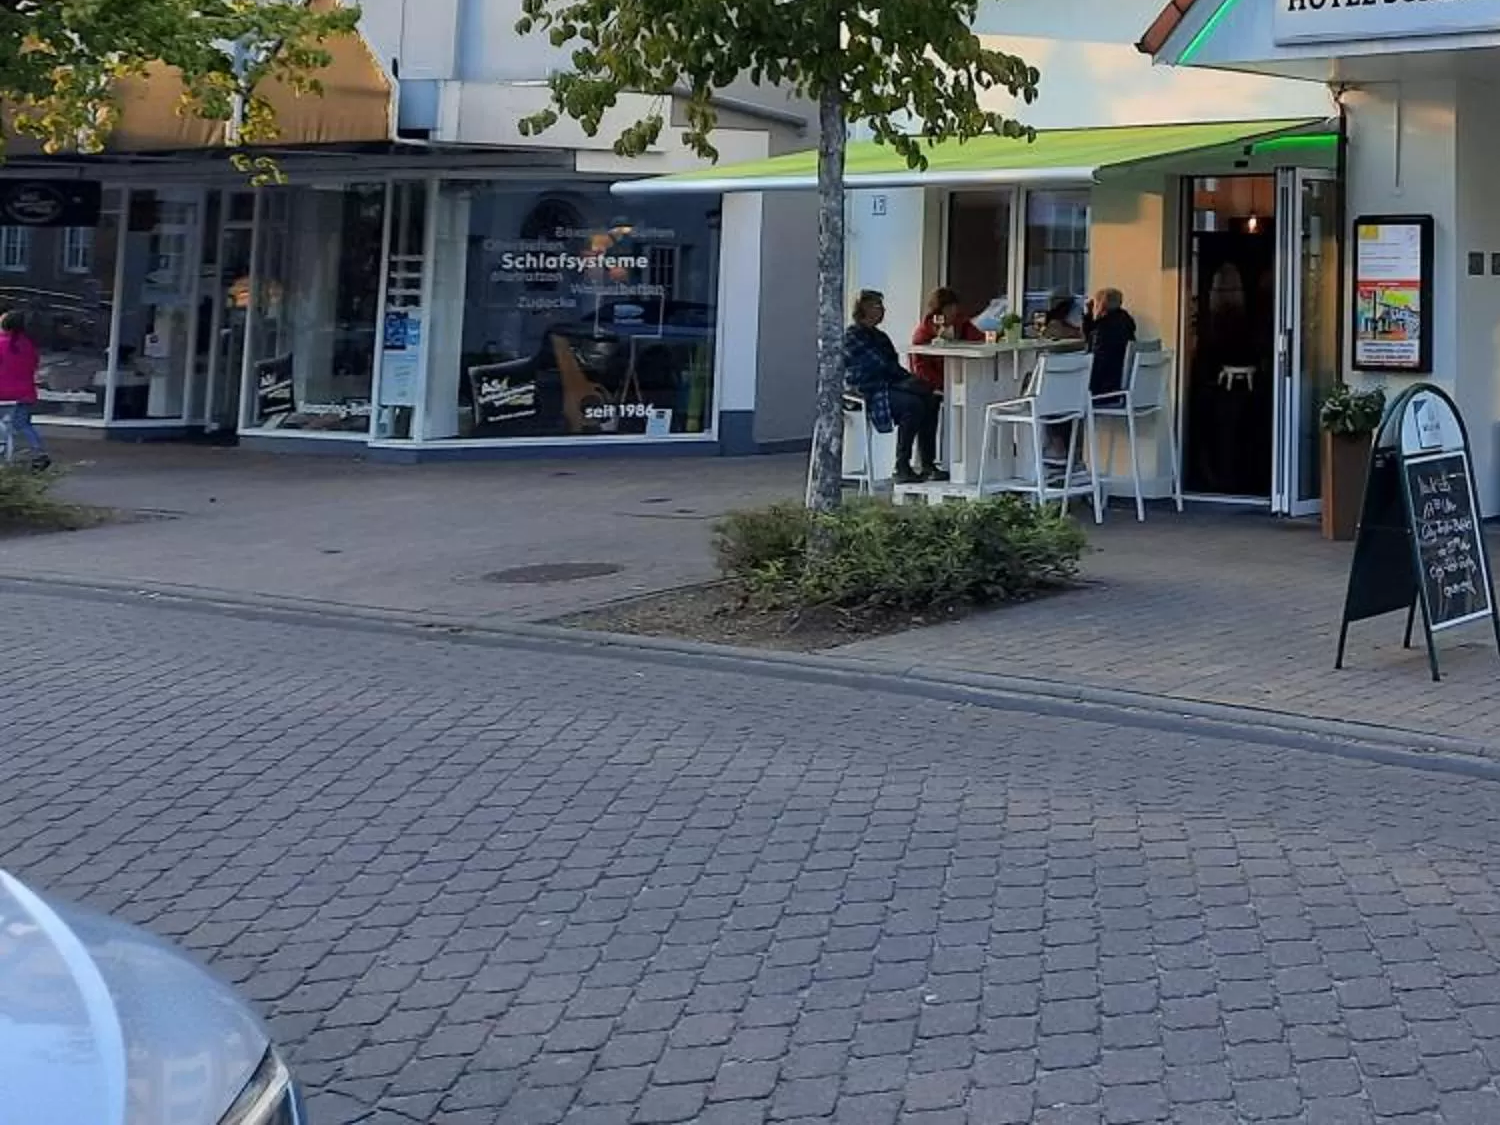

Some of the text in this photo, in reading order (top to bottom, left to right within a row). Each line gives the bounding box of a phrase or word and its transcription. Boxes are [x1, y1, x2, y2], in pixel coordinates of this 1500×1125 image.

[501, 252, 649, 273] Schlafsysteme
[584, 402, 653, 419] seit 1986
